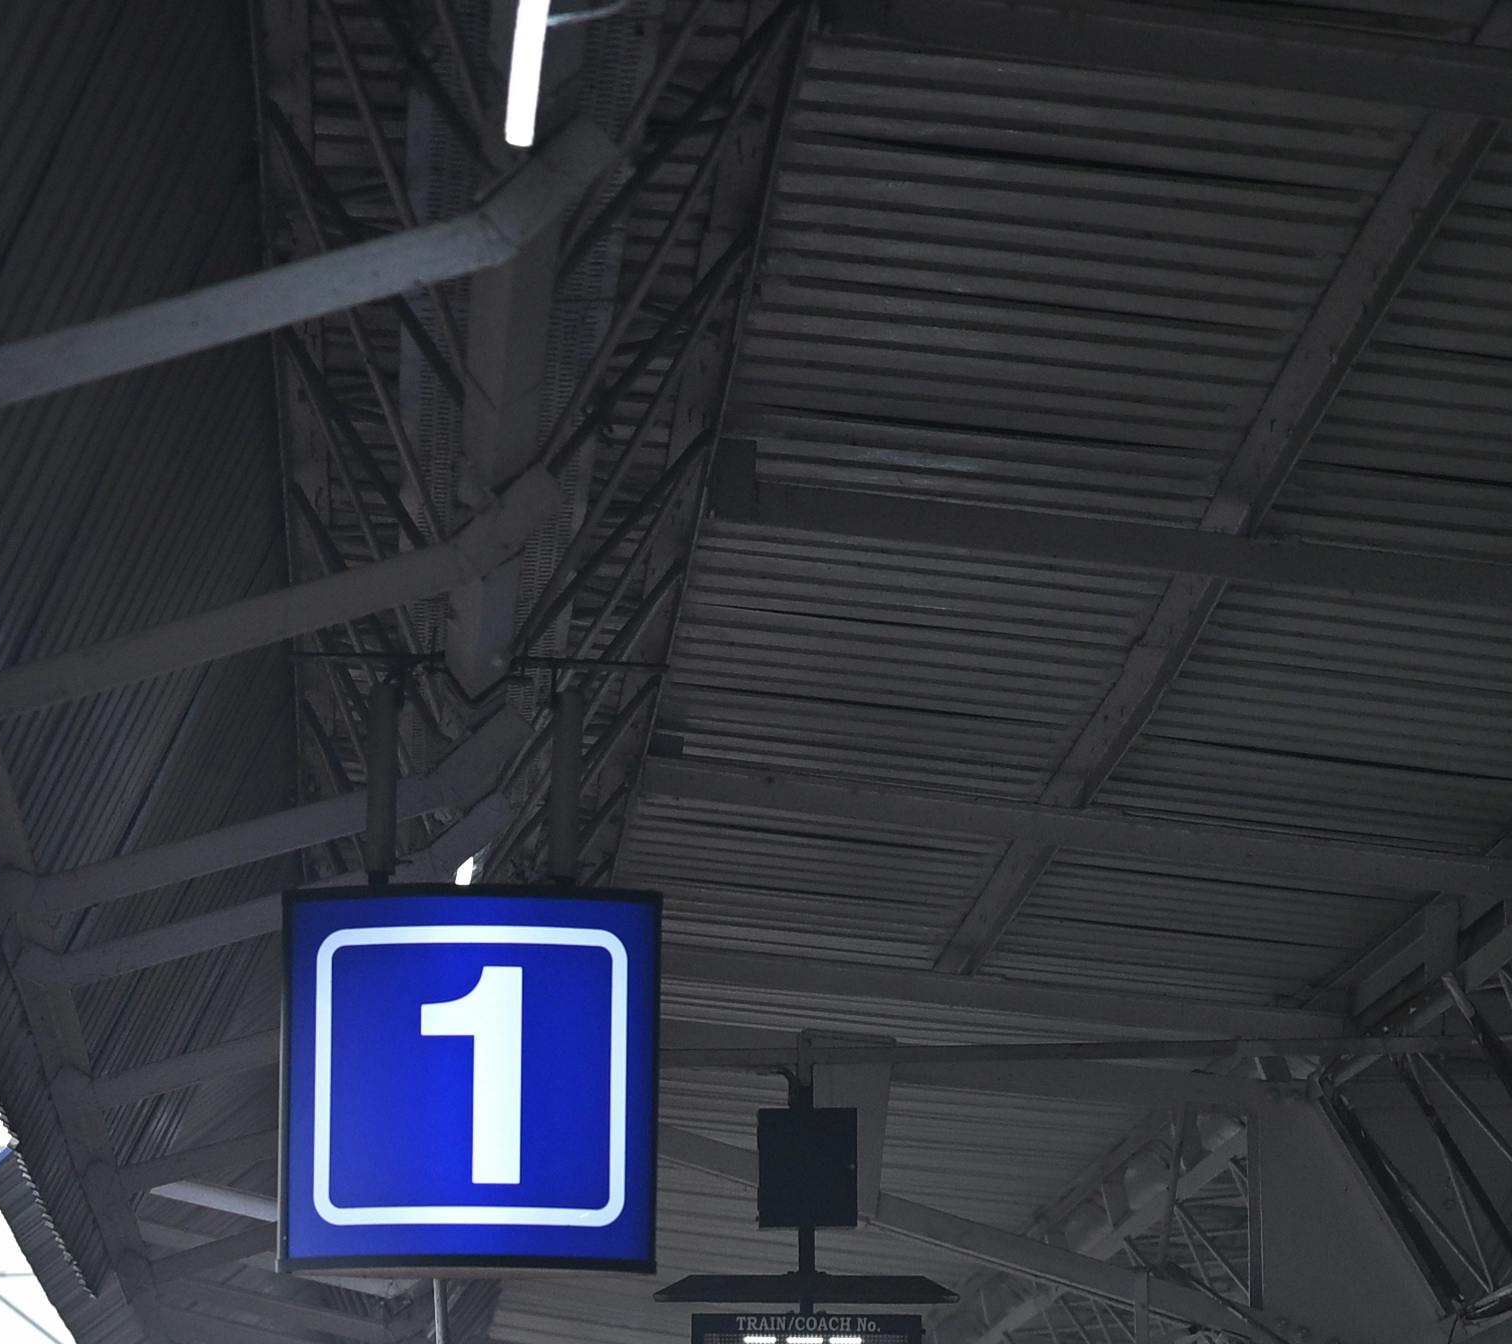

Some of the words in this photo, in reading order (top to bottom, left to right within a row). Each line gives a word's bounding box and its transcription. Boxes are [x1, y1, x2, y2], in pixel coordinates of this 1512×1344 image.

[420, 966, 523, 1184] 1
[736, 1316, 852, 1331] TRAIN/COACH
[856, 1316, 881, 1332] No.
